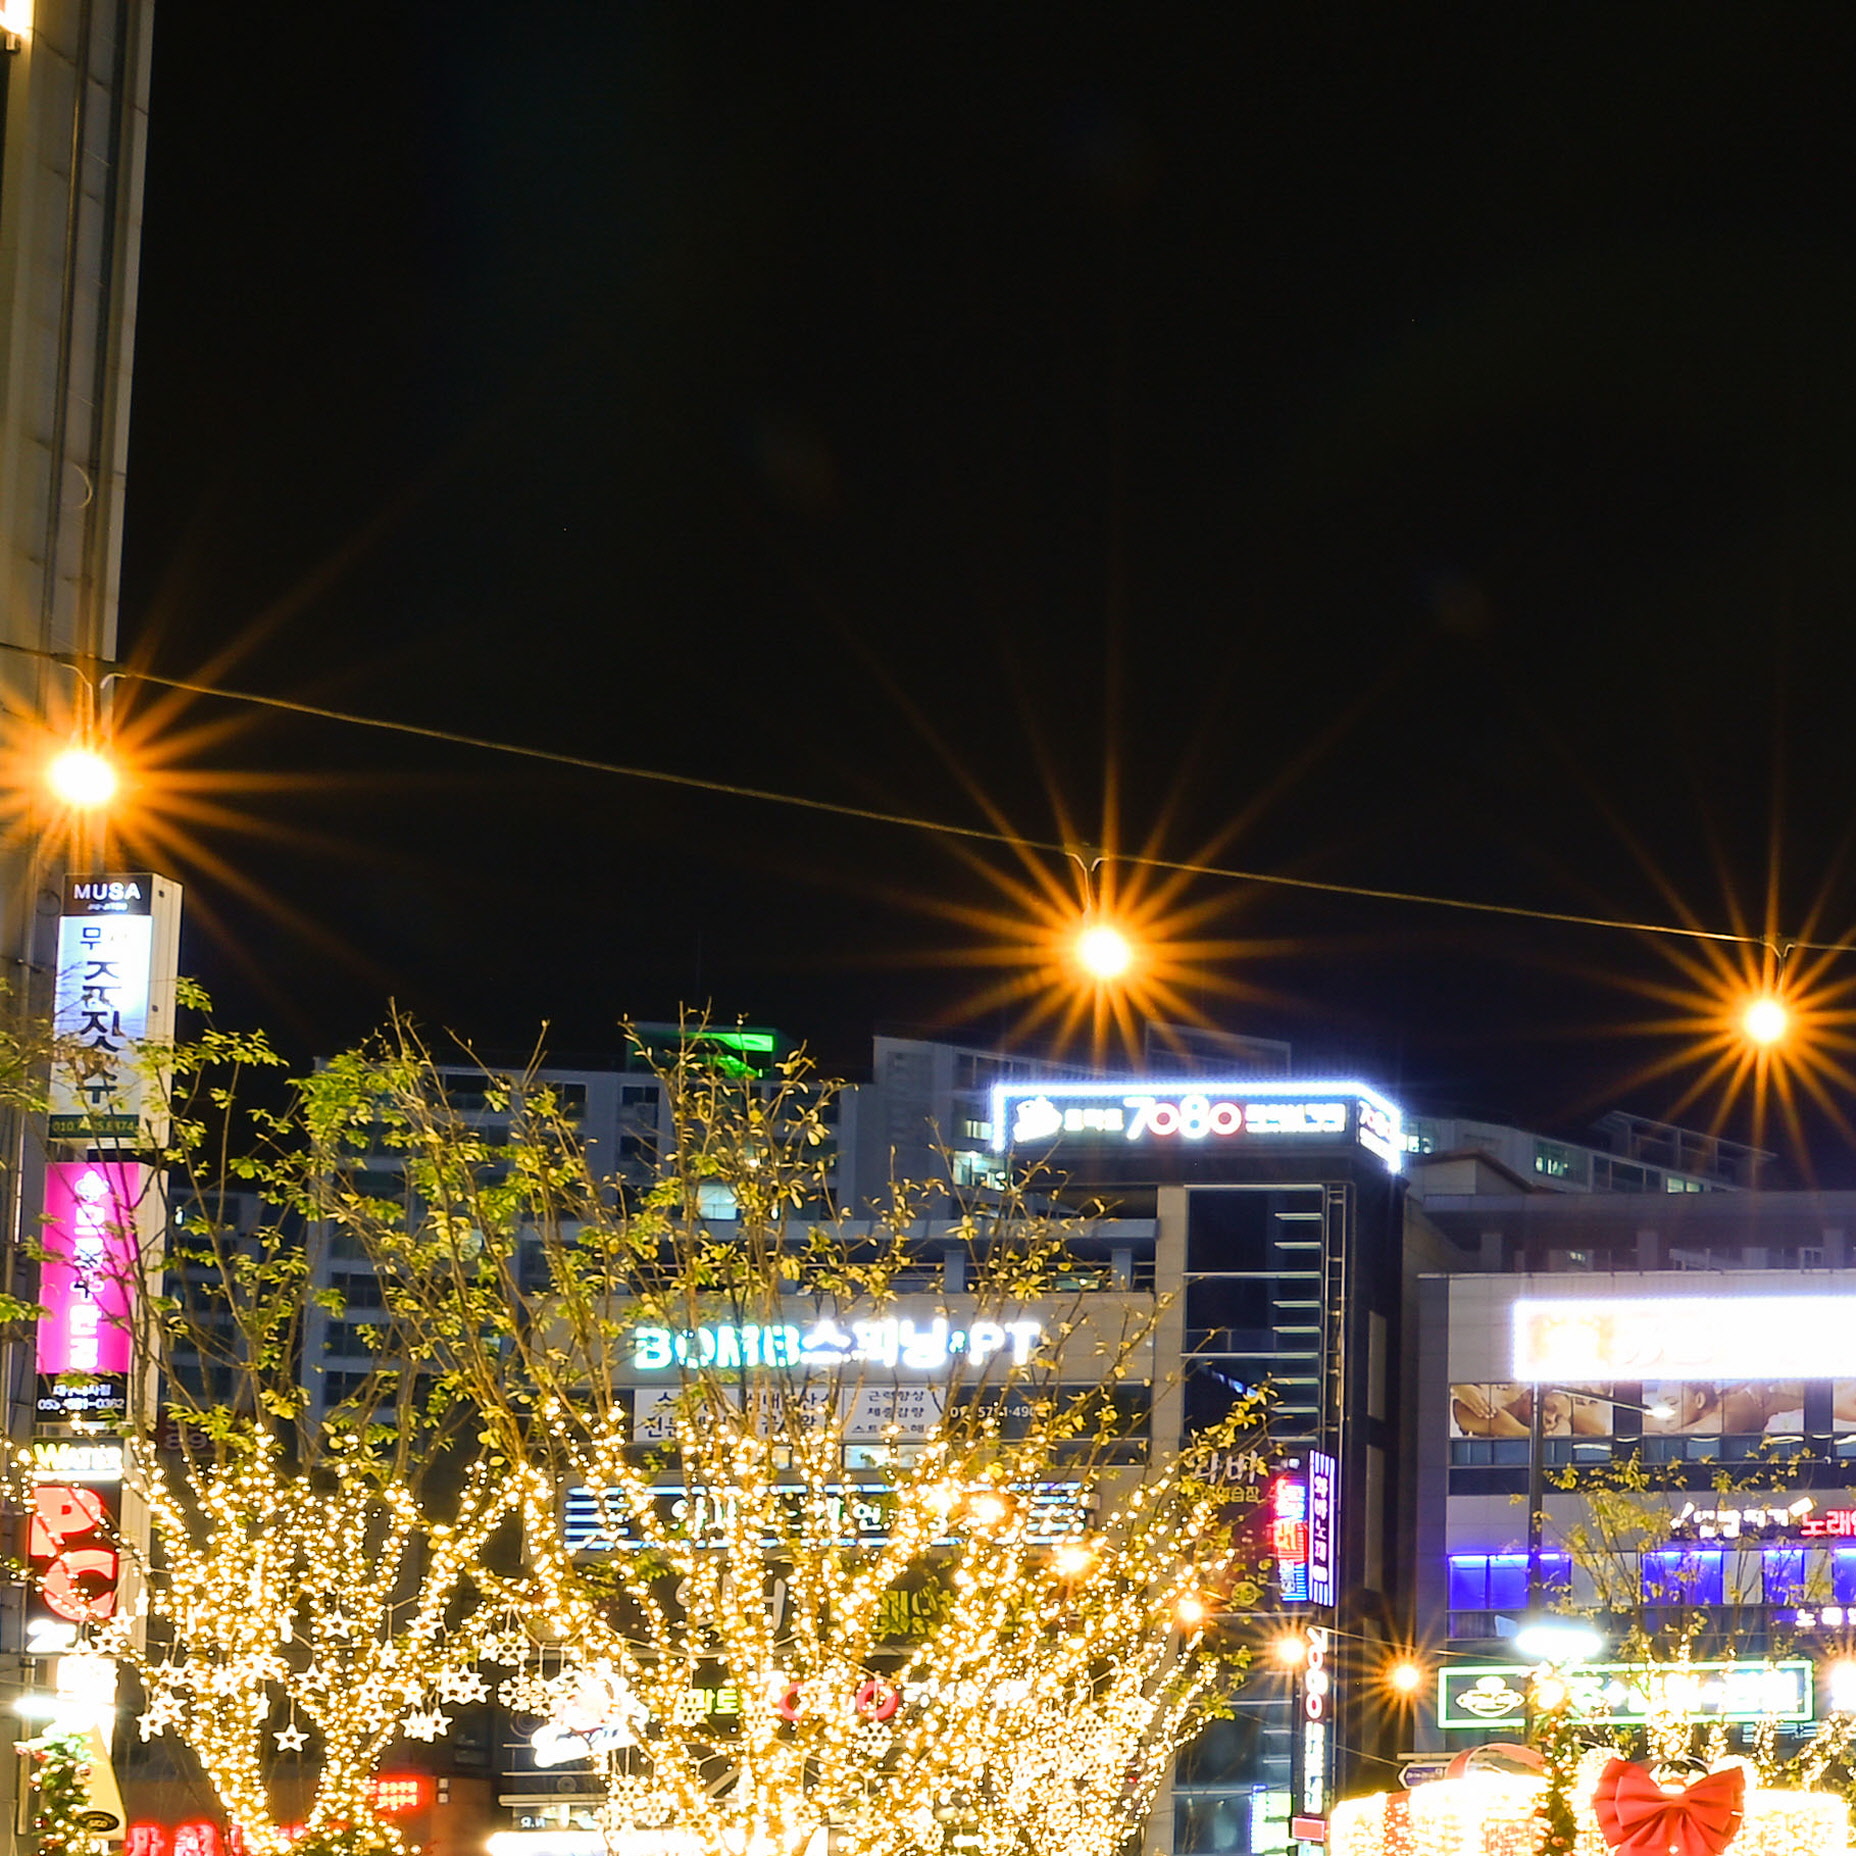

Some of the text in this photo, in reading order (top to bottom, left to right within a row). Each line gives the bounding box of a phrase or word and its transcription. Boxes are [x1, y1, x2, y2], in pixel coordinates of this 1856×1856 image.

[73, 883, 142, 900] MUSA
[1123, 1096, 1243, 1141] 7080
[30, 1486, 119, 1622] PC
